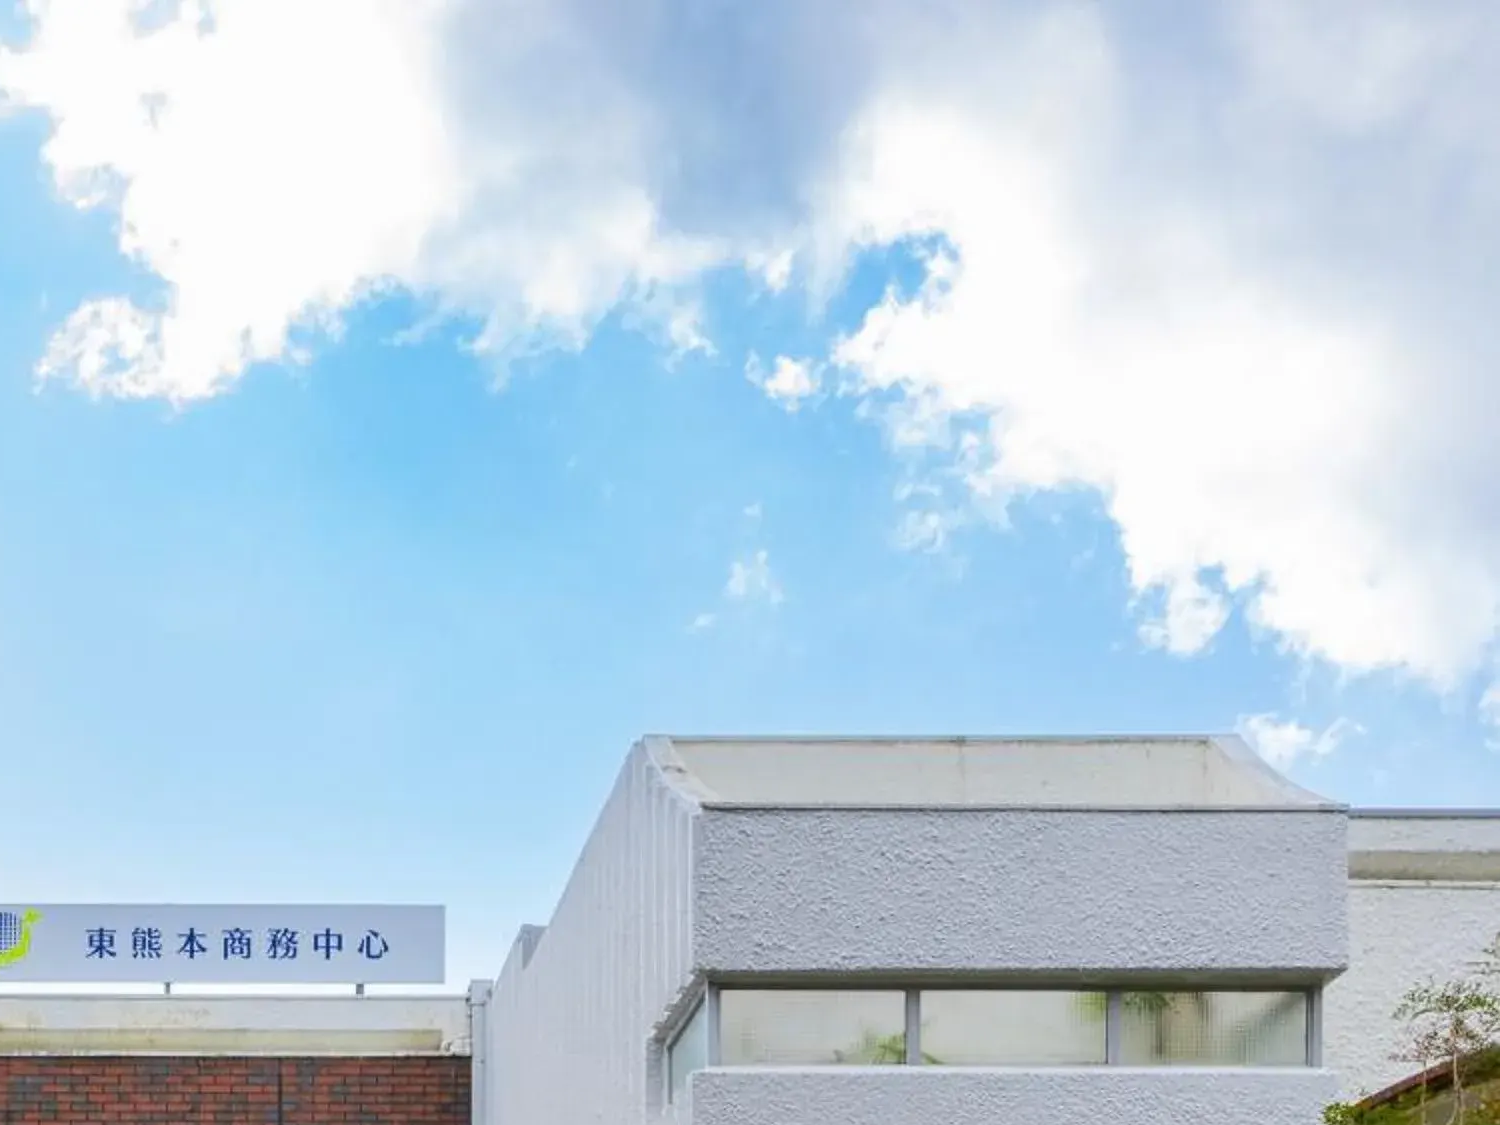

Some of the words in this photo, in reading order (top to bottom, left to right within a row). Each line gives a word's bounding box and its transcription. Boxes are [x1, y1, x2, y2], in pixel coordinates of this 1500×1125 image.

[85, 926, 390, 960] 東熊本商務中心
